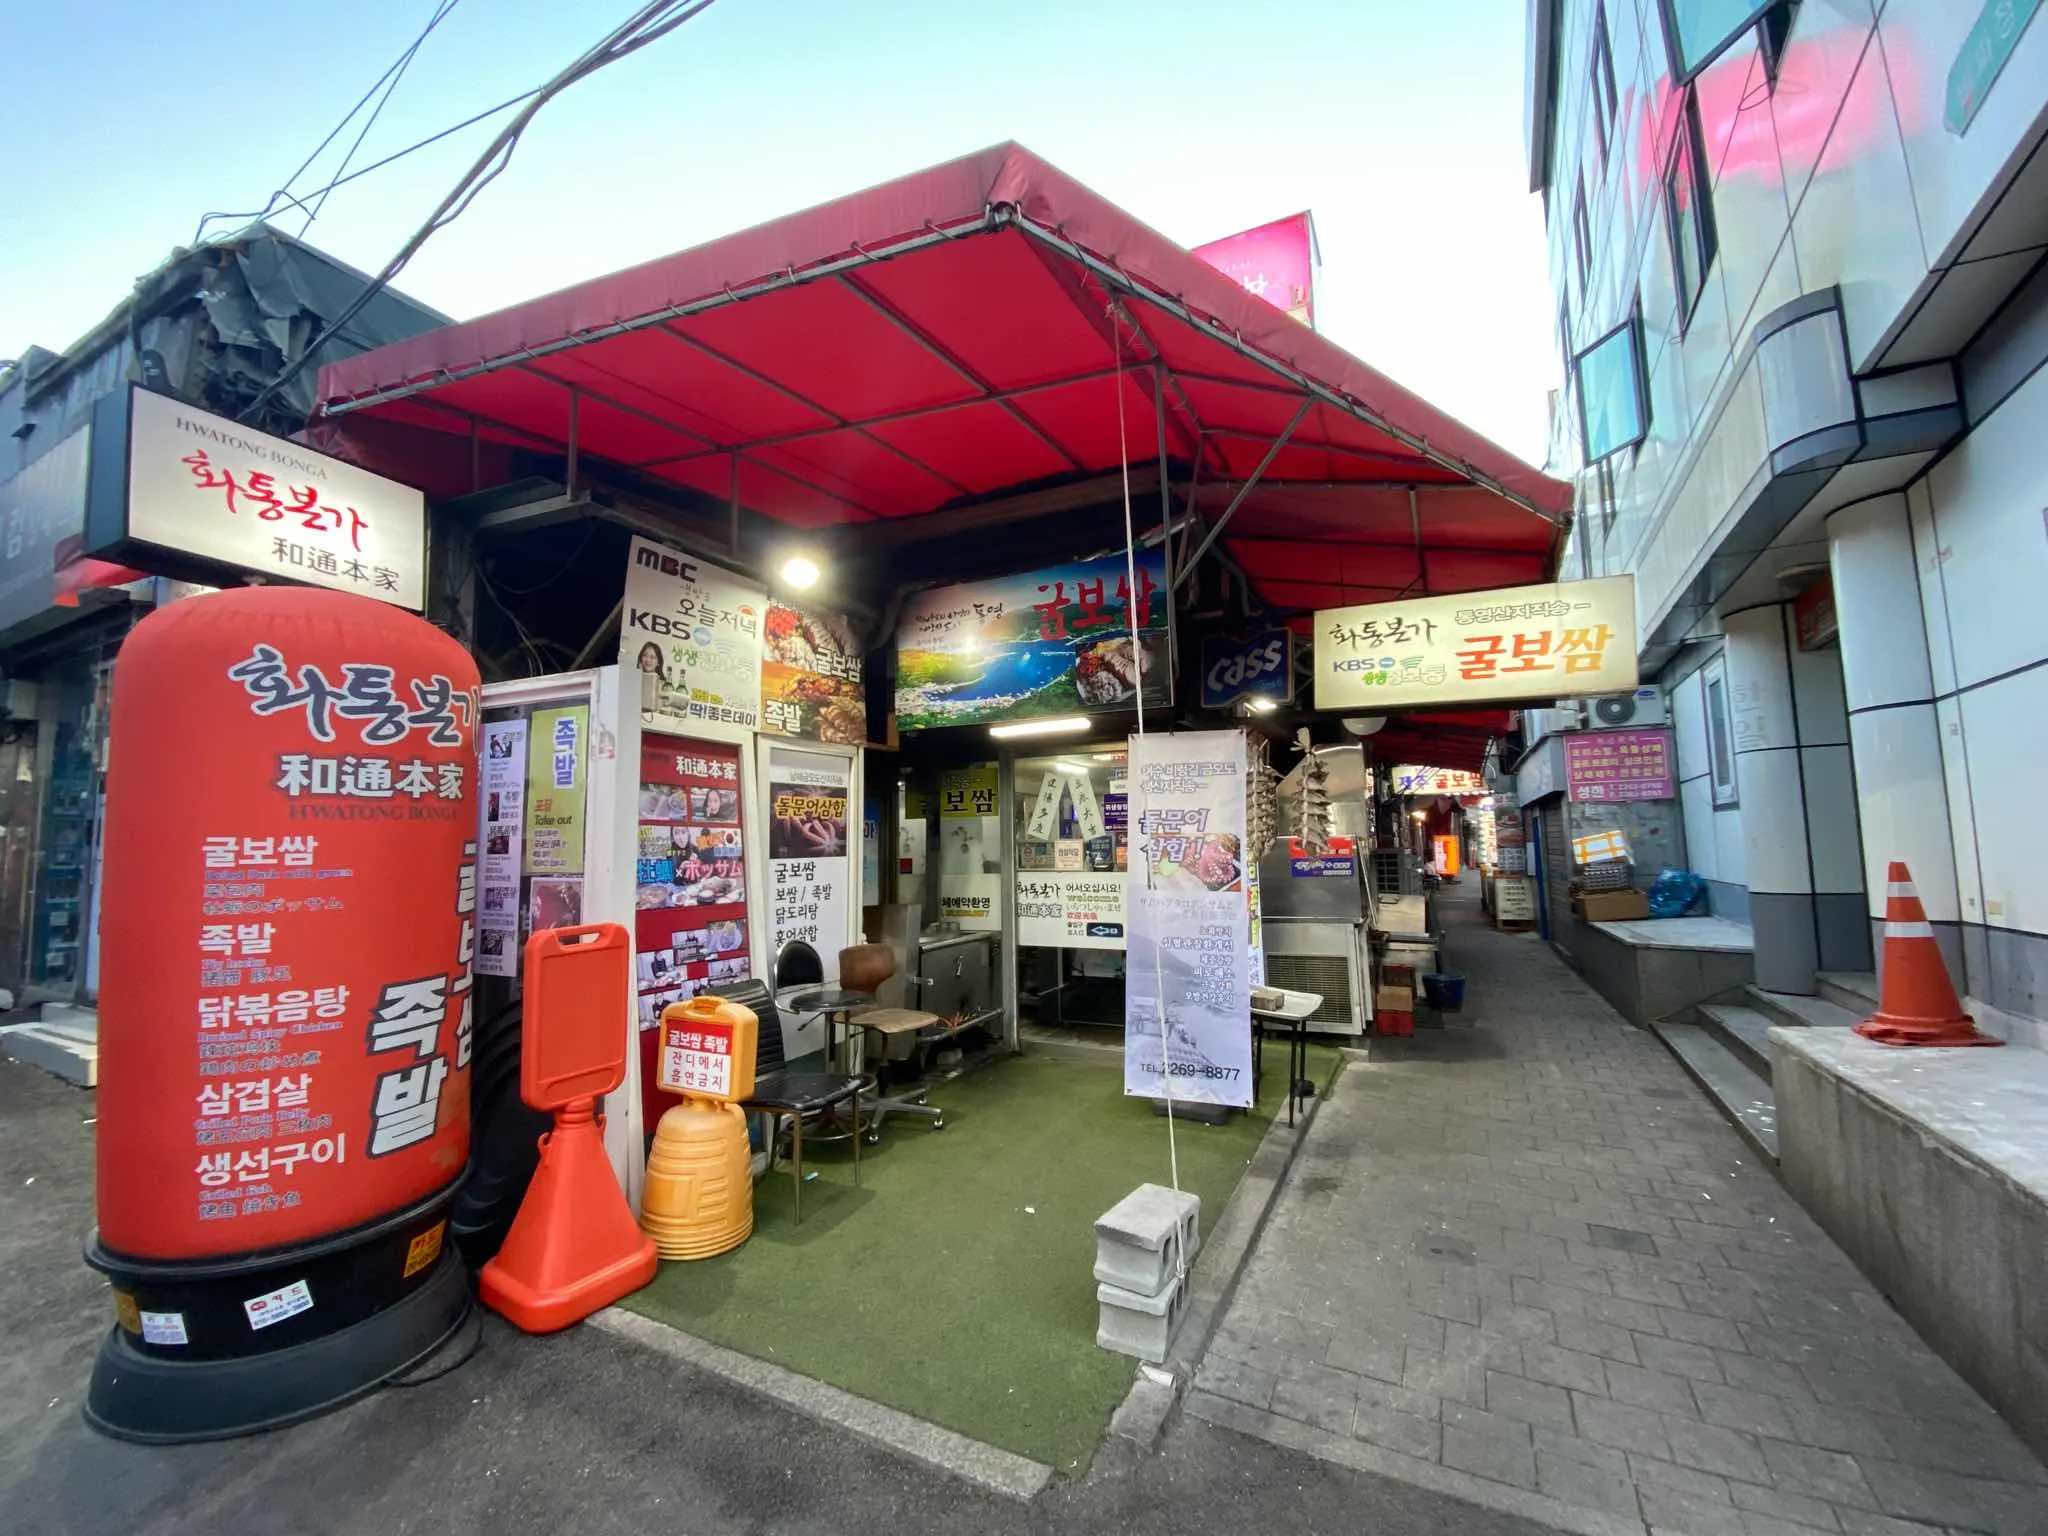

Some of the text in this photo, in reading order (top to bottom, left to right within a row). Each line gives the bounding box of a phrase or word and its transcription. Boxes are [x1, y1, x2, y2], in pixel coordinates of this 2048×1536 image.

[175, 417, 329, 481] HWATONG BONGA
[182, 448, 369, 552] 화통본가
[271, 536, 400, 593] 和通本家
[676, 598, 758, 640] 오늘저녁
[1032, 565, 1158, 642] 굴보쌈
[629, 607, 691, 641] KBS
[1328, 616, 1438, 650] 화통본가
[815, 645, 862, 683] 굴보쌈
[1332, 658, 1376, 672] KBS
[1455, 624, 1614, 680] 굴보쌈
[764, 700, 802, 732] 족발
[555, 717, 577, 788] 족발
[675, 756, 738, 781] 和通本家
[275, 752, 466, 802] 和通本家
[288, 804, 403, 822] HWATONG
[775, 795, 847, 819] 돌문어삼합
[943, 787, 997, 813] 보쌈
[557, 815, 573, 825] out
[202, 836, 319, 868] 굴보쌈
[775, 861, 817, 884] 굴보쌈
[775, 886, 798, 904] 보쌈
[811, 883, 833, 901] 족발
[775, 903, 818, 925] 닭도리탕
[199, 921, 277, 956] 족발
[774, 925, 819, 947] 홍어삼합
[198, 984, 350, 1029] 닭볶음탕
[669, 1030, 729, 1054] 굴보쌈 족발
[366, 973, 448, 1160] 족발
[672, 1051, 724, 1073] 잔디에서
[196, 1073, 313, 1116] 삼겹살
[671, 1068, 723, 1092] 흡연금지
[195, 1132, 346, 1186] 생선구이
